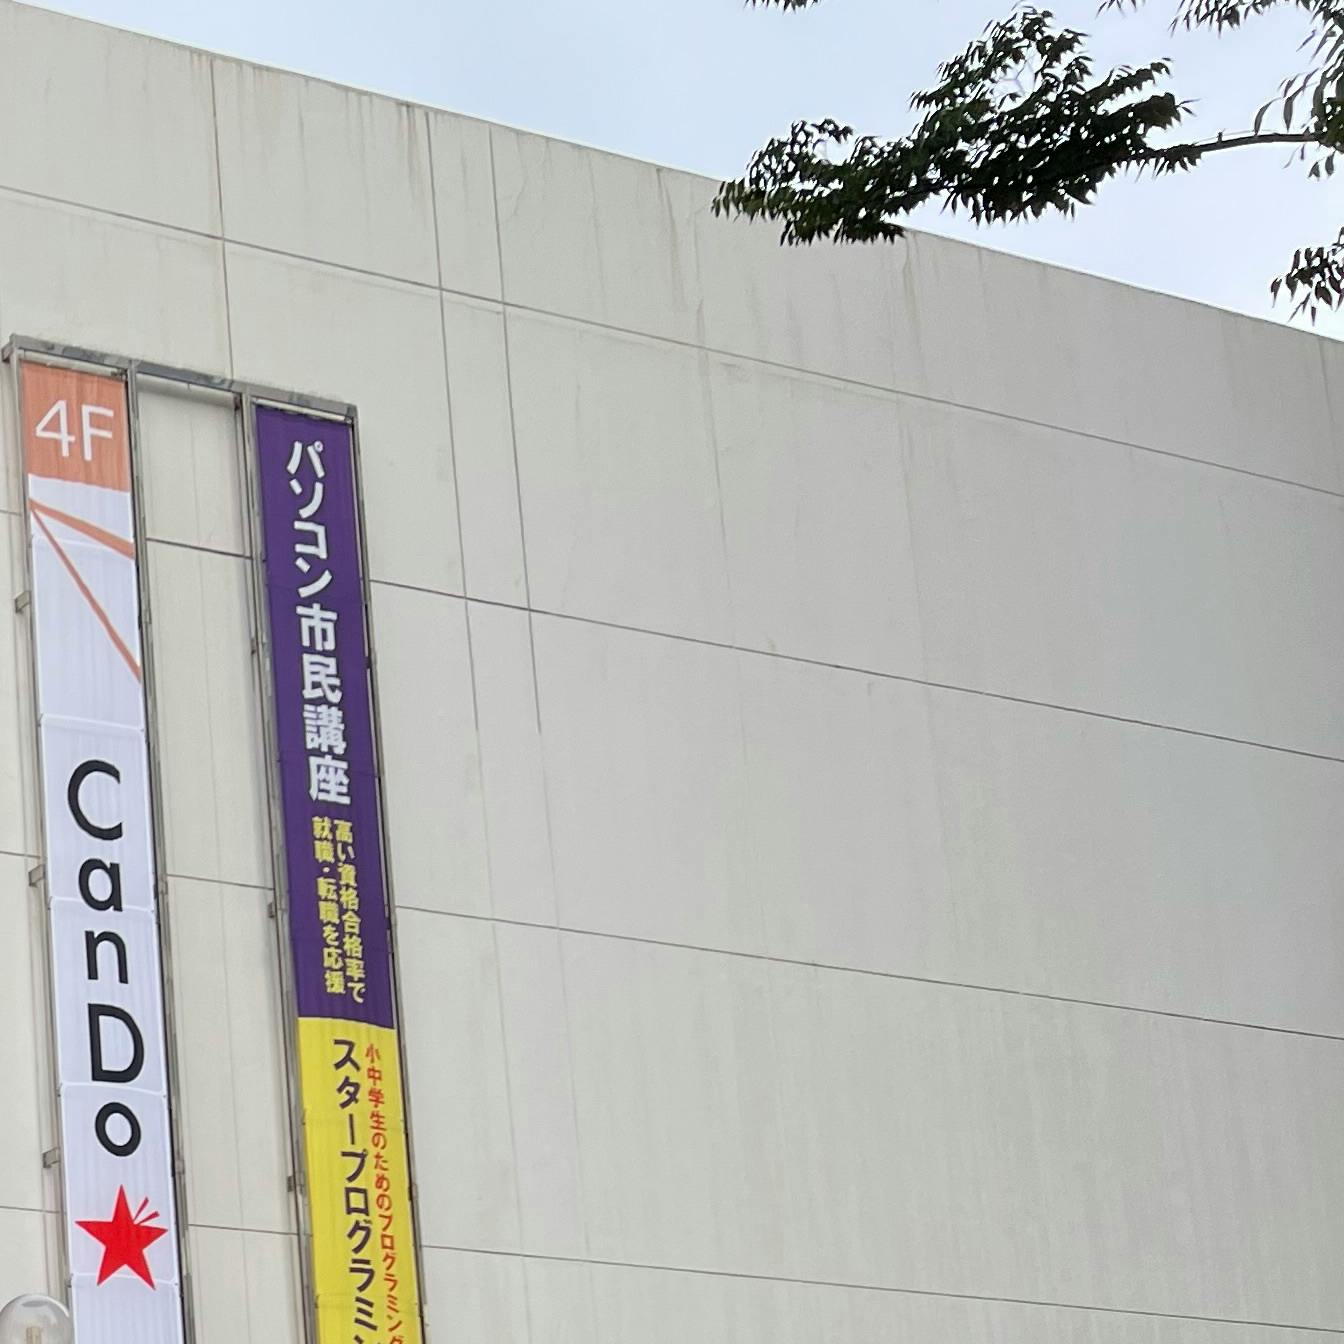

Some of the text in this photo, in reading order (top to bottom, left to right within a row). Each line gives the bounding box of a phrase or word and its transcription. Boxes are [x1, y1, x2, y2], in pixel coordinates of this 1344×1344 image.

[35, 400, 113, 460] 4F
[286, 441, 351, 804] パソコン市民講座
[334, 819, 365, 1003] 高い資格合格率で
